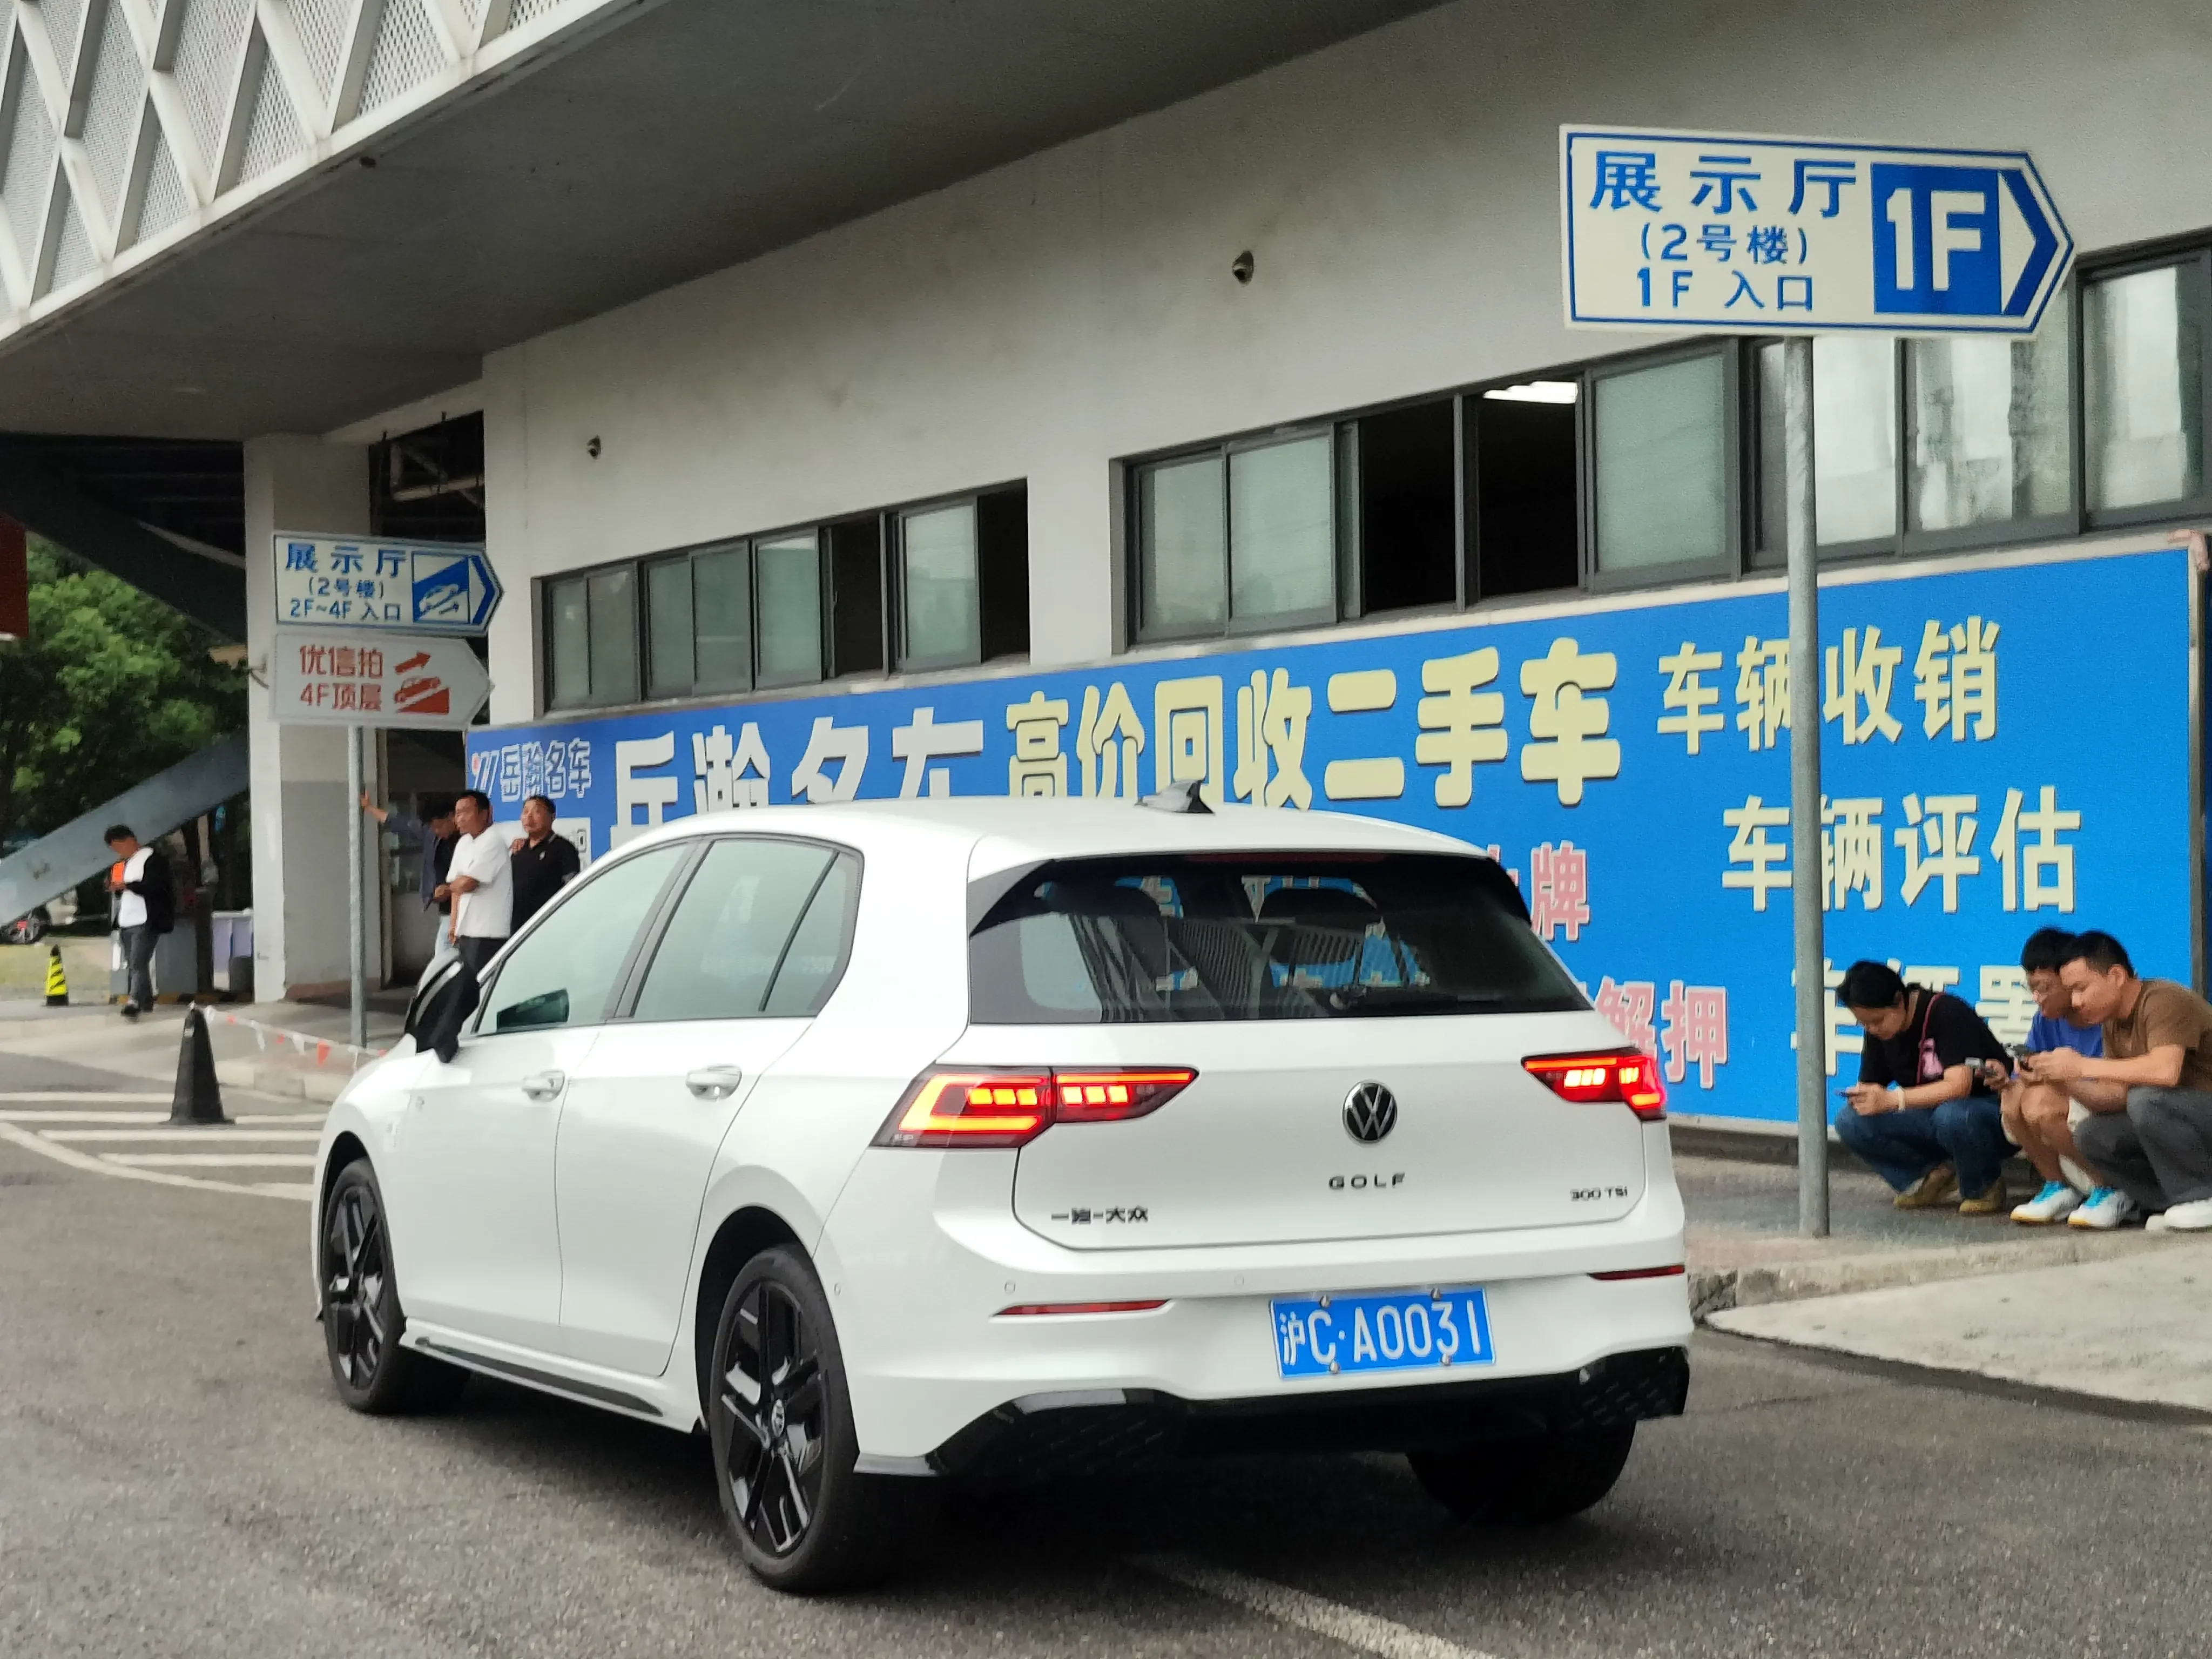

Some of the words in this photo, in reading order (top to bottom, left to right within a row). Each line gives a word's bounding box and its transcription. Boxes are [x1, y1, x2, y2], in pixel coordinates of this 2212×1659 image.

[1588, 151, 1858, 218] 展示厅
[1640, 222, 1809, 265] (2号楼)
[1886, 187, 1985, 291] 1F
[1636, 267, 1693, 308] 1F
[1724, 269, 1813, 312] 入口
[286, 543, 407, 578] 展示厅
[360, 601, 401, 621] 入口
[300, 644, 383, 679] 优信拍
[1656, 615, 2000, 756] 车辆收销
[1006, 637, 1620, 810] 高价回收二手车
[1721, 785, 2082, 914] 车辆评估
[1328, 1172, 1406, 1189] GOLF
[1569, 1187, 1601, 1202] 300
